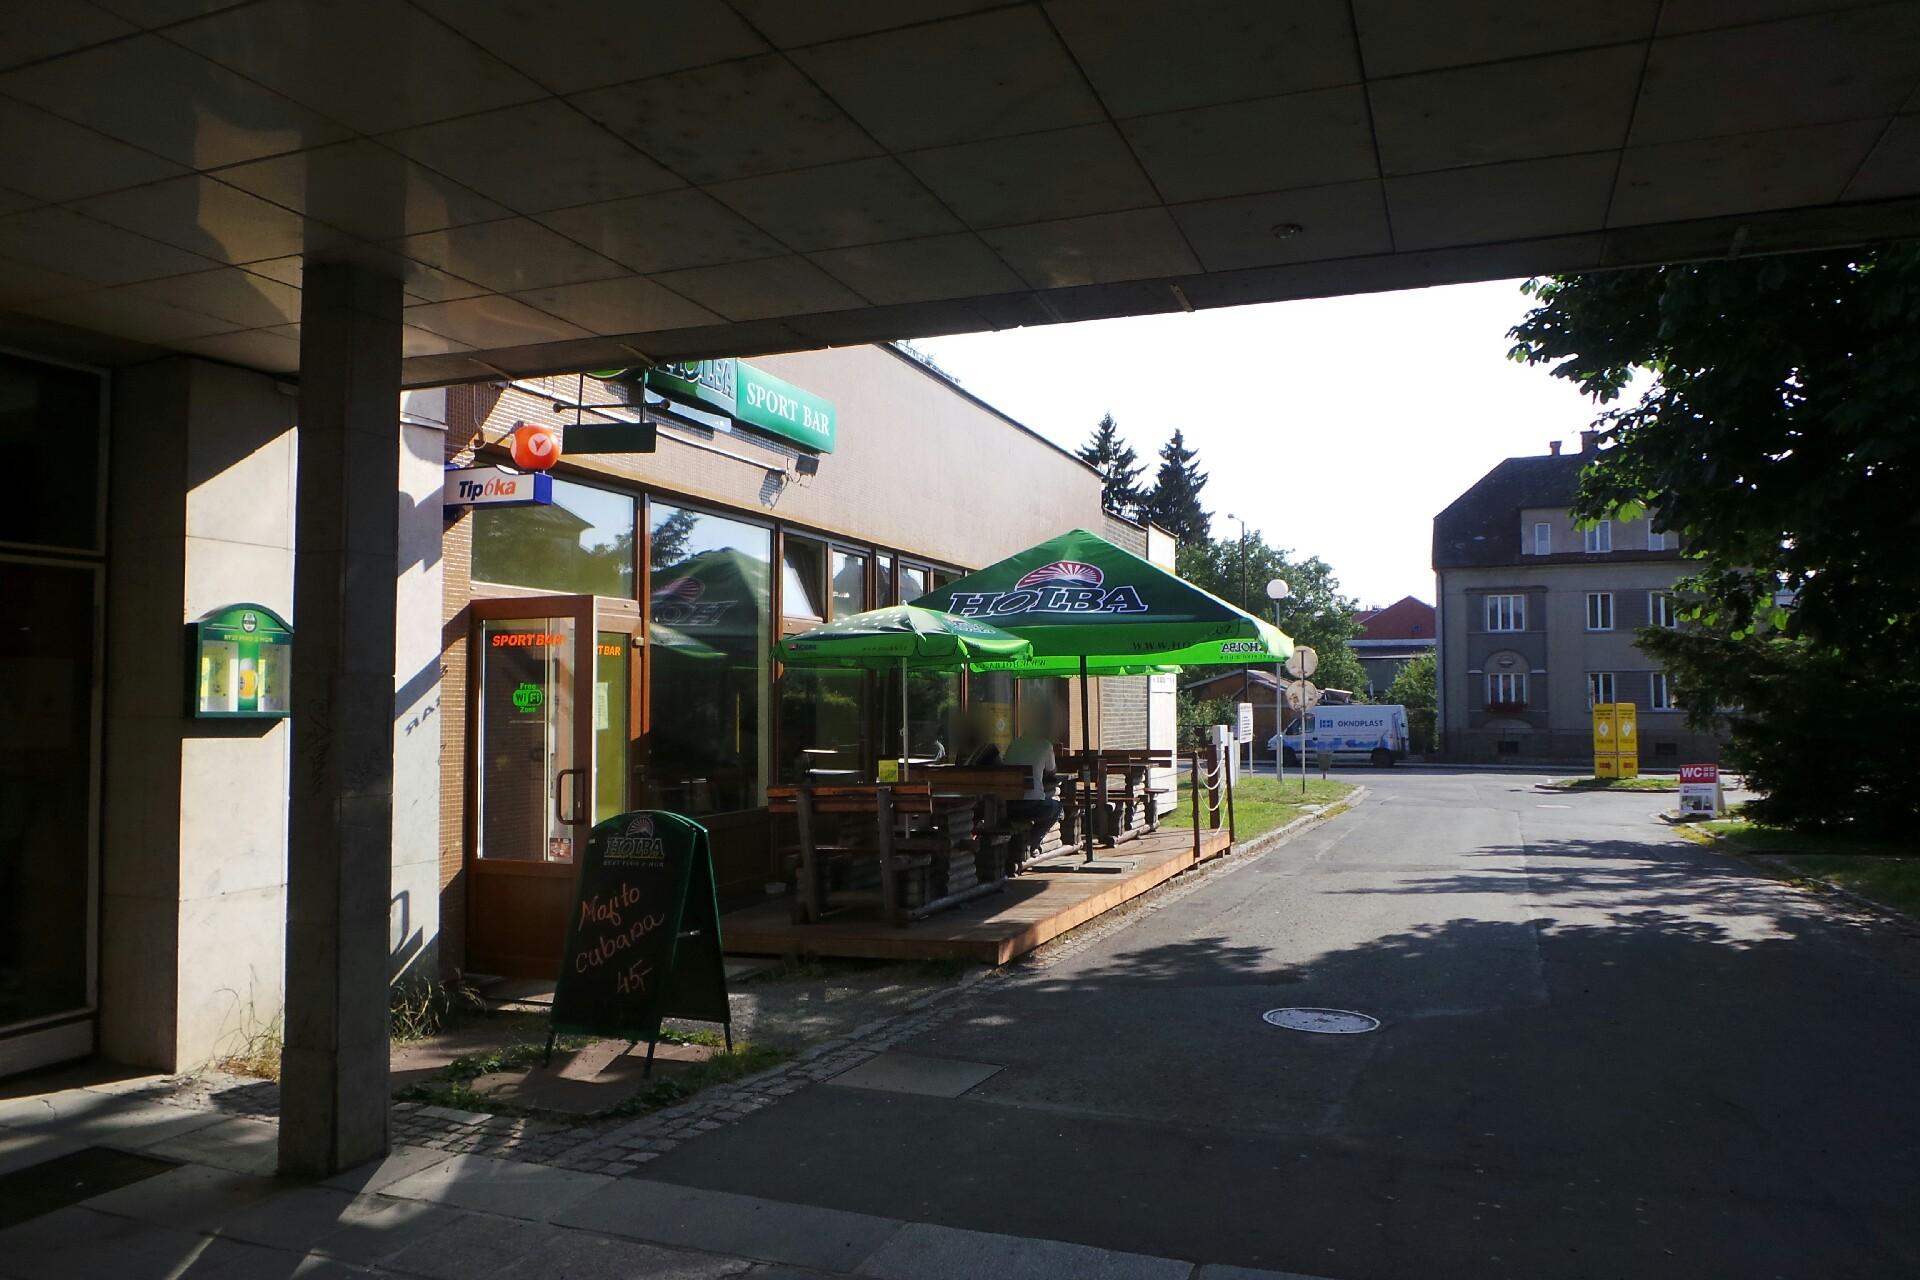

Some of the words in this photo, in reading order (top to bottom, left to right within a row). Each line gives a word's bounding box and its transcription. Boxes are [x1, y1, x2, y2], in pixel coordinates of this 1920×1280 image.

[746, 382, 799, 422] SPORT
[802, 405, 830, 436] BAR
[948, 586, 1149, 618] HOLBA
[492, 634, 535, 647] SPORT
[603, 645, 621, 656] BAR
[1337, 719, 1384, 728] OKNOPLAST
[1681, 767, 1703, 778] WC
[604, 837, 665, 859] HOLBA
